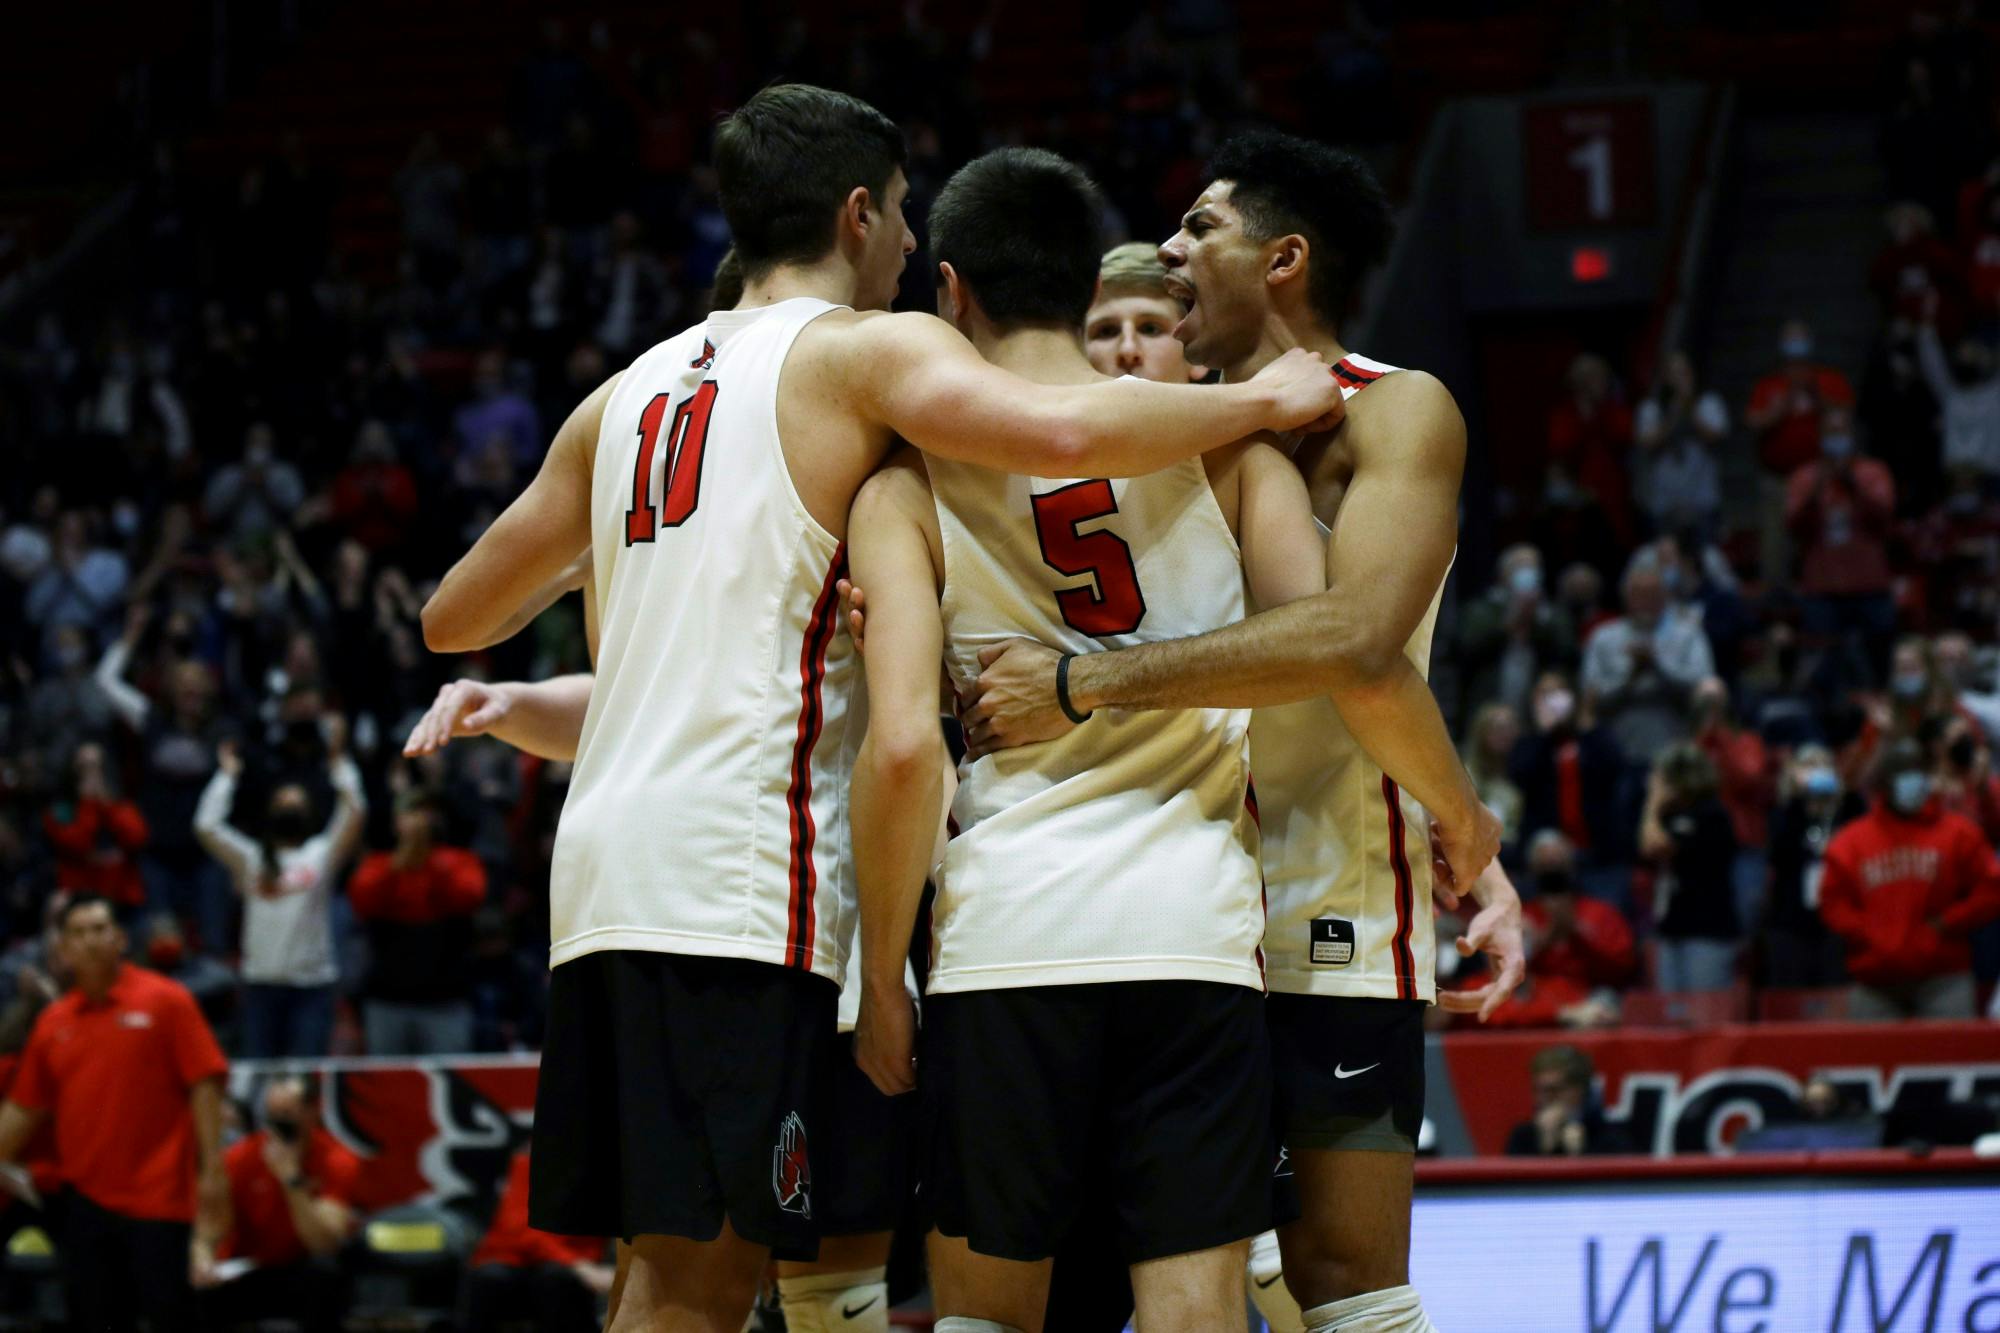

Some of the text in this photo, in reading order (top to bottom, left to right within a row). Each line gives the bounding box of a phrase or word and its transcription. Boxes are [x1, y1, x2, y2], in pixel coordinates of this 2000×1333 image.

[1564, 136, 1613, 222] 1
[626, 379, 718, 547] 10
[1030, 478, 1147, 638] 5
[1328, 924, 1339, 938] L
[1584, 1232, 1777, 1333] We
